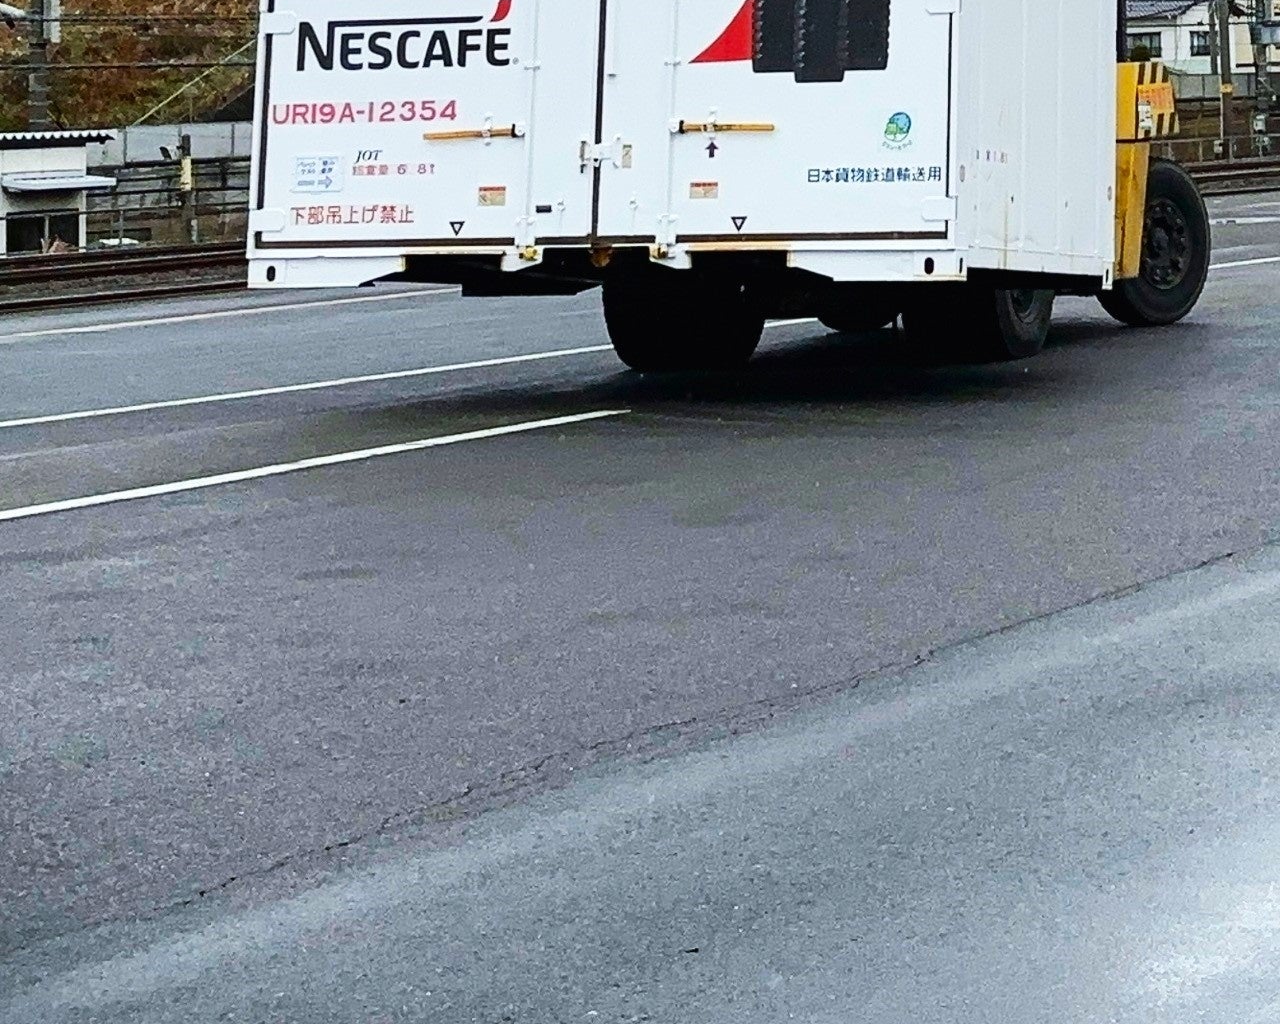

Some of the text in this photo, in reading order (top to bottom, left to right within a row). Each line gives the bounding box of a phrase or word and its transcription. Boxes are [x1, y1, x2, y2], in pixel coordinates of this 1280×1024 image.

[272, 100, 457, 124] UR19A-12354
[355, 149, 383, 163] JOT
[807, 166, 942, 183] 日本貨物鉄道輸送用
[290, 204, 415, 225] 下部吊上げ禁止
